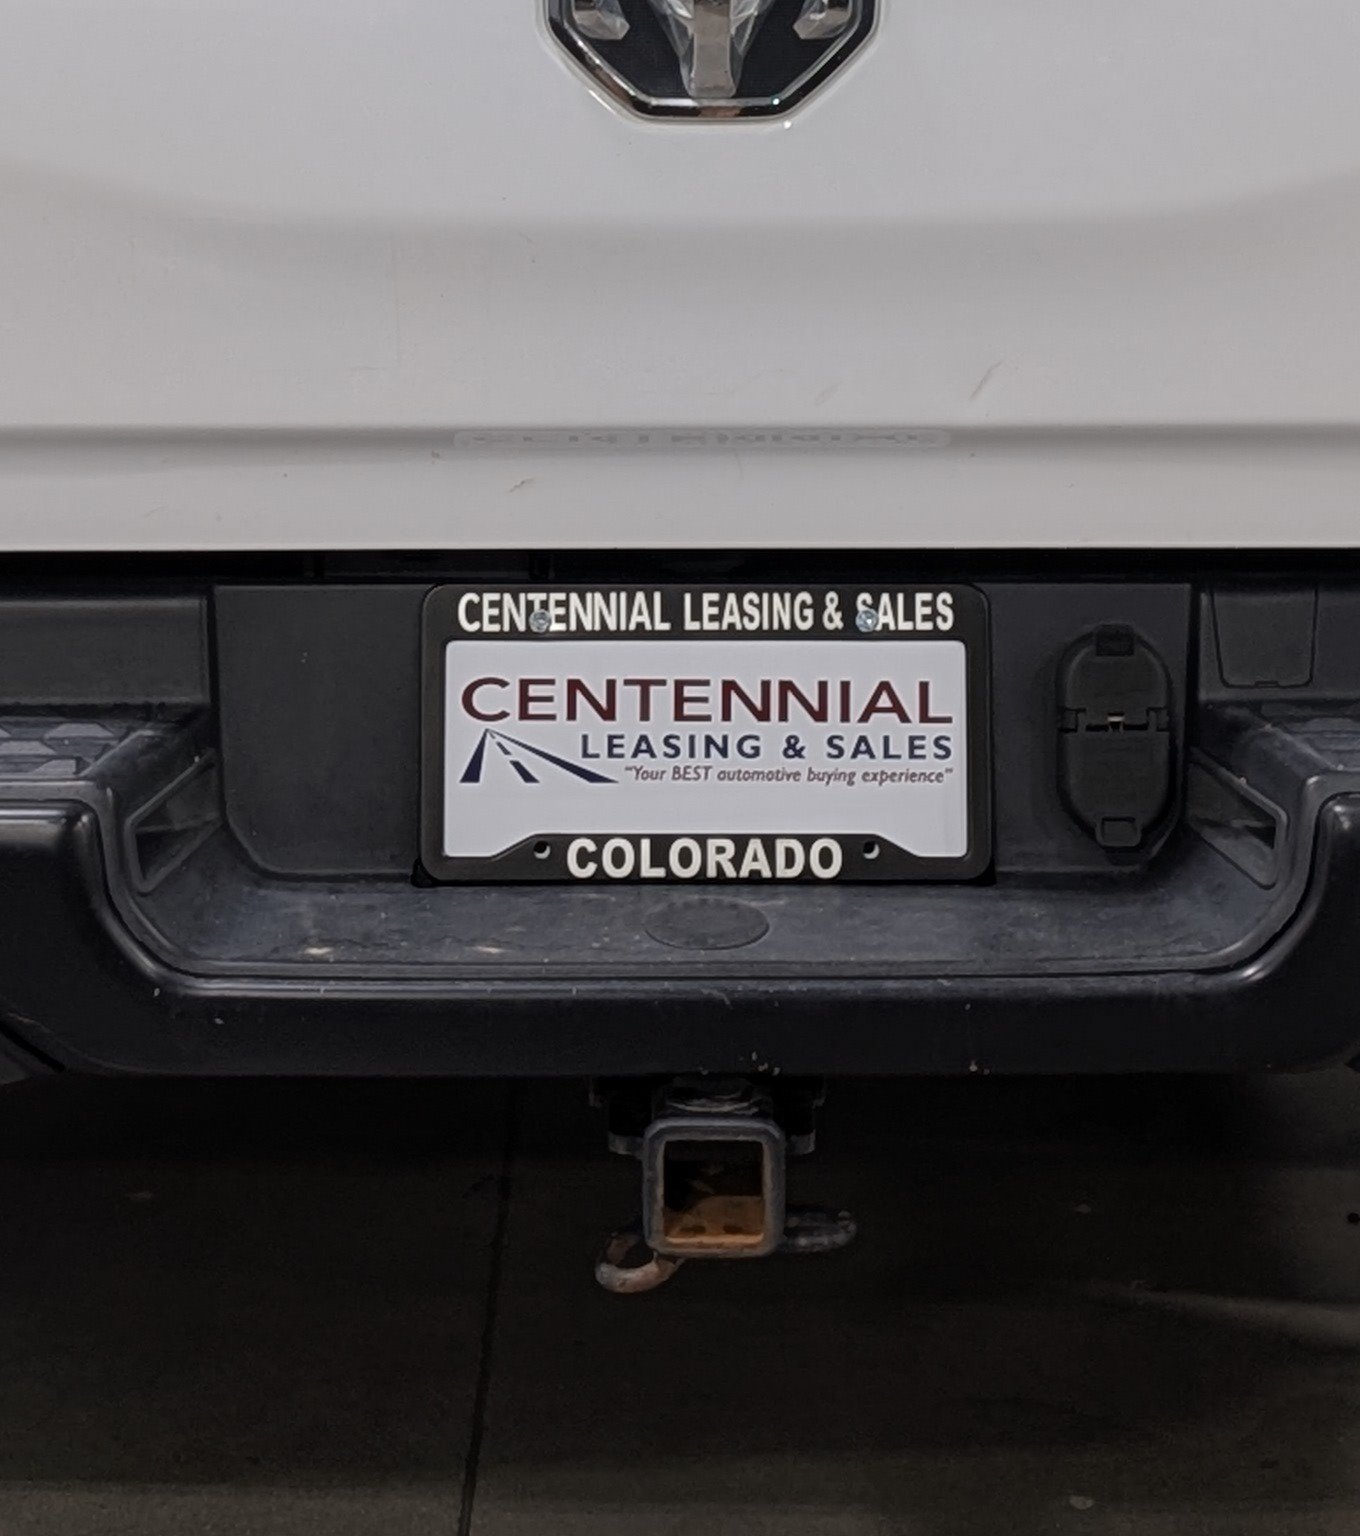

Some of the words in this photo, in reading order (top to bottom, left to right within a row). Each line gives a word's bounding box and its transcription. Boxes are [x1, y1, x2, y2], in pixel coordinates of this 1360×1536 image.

[683, 591, 814, 631] LEASING
[822, 592, 843, 631] &
[461, 676, 953, 724] CENTENNIAL
[581, 734, 761, 760] LEASING
[783, 735, 805, 759] &
[827, 734, 952, 760] SALES
[672, 766, 711, 781] BEST
[717, 767, 801, 782] automotive
[807, 767, 855, 786] buying
[566, 837, 841, 879] COLORADO
